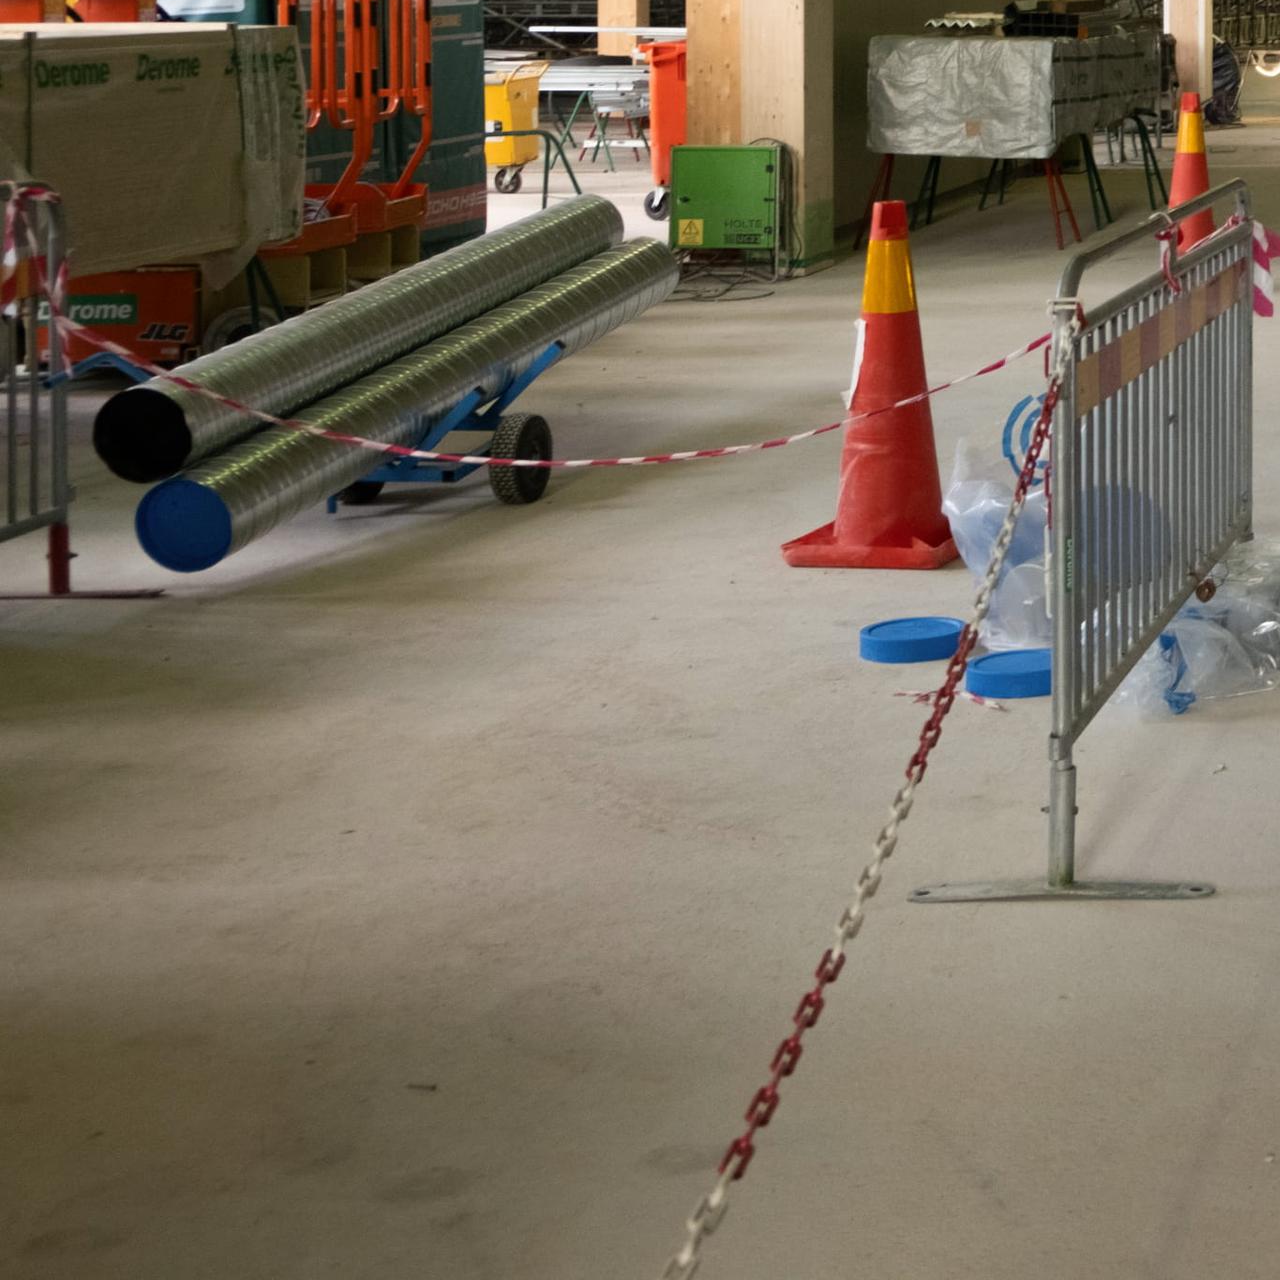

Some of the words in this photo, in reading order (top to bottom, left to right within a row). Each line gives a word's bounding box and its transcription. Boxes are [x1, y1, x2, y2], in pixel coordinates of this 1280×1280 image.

[36, 59, 111, 89] Derome
[136, 53, 201, 82] Derome
[37, 301, 133, 320] Drome
[139, 322, 189, 341] JLG
